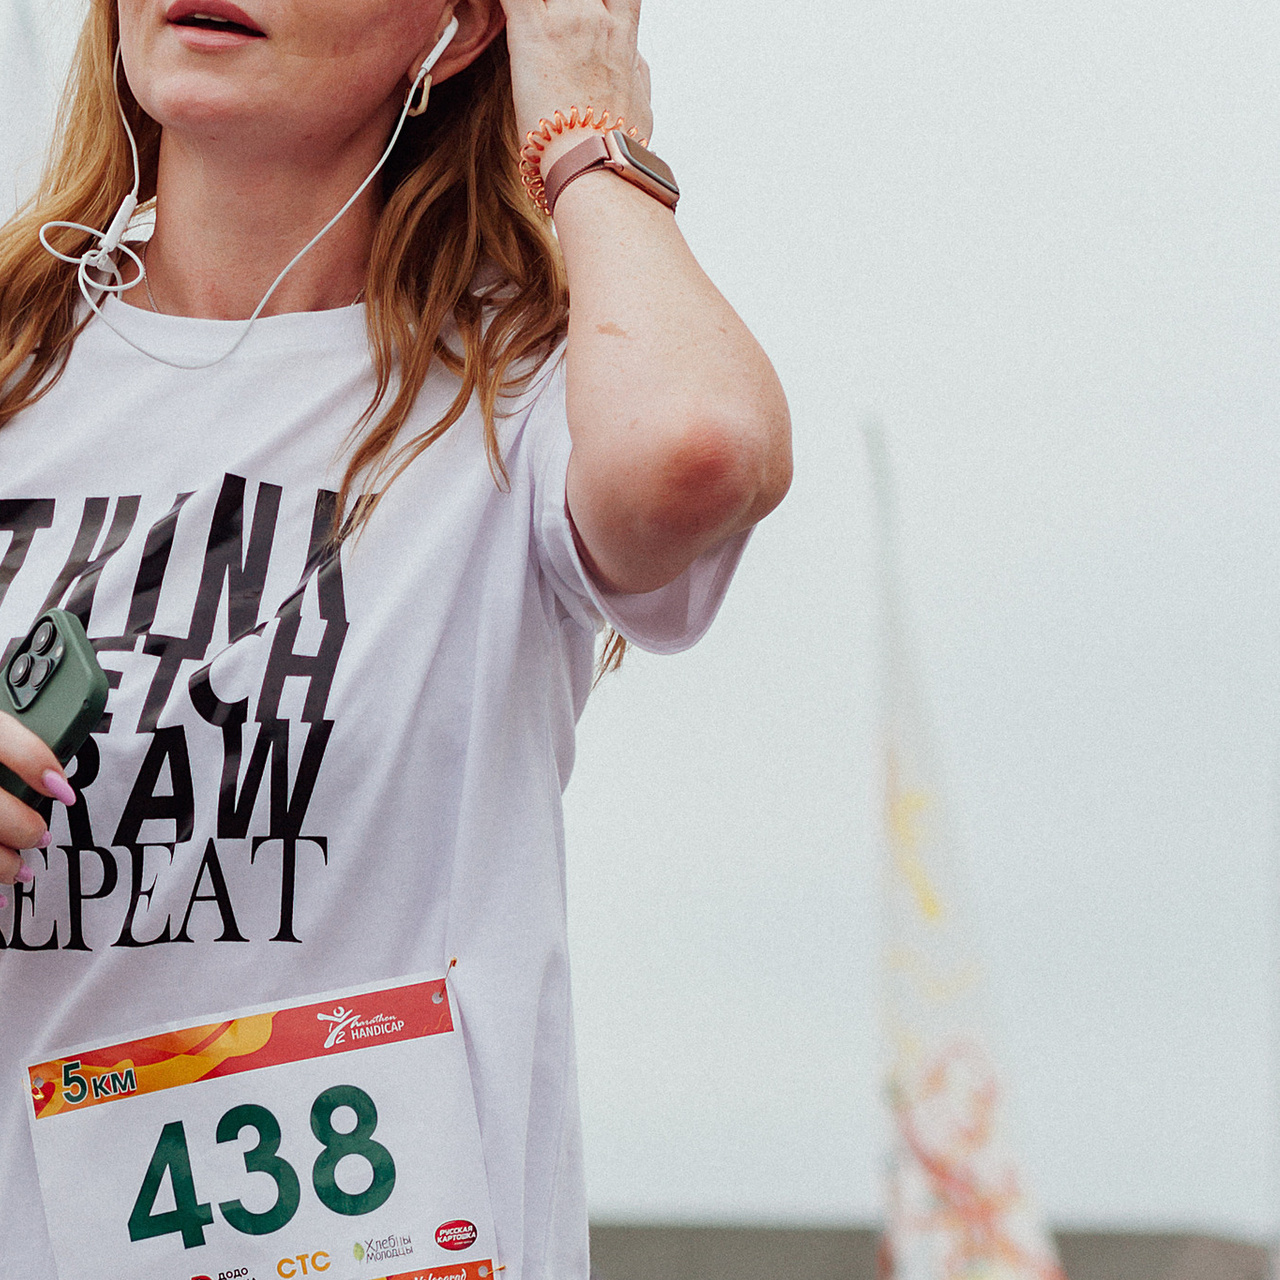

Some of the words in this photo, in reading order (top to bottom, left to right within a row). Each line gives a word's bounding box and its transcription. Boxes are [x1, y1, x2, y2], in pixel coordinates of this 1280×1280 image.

[37, 719, 336, 847] RAW
[351, 1021, 405, 1040] HANDICAP
[62, 1060, 88, 1104] 5
[127, 1084, 397, 1250] 438
[439, 1225, 473, 1237] РУССКАЯ
[276, 1251, 331, 1279] СТС
